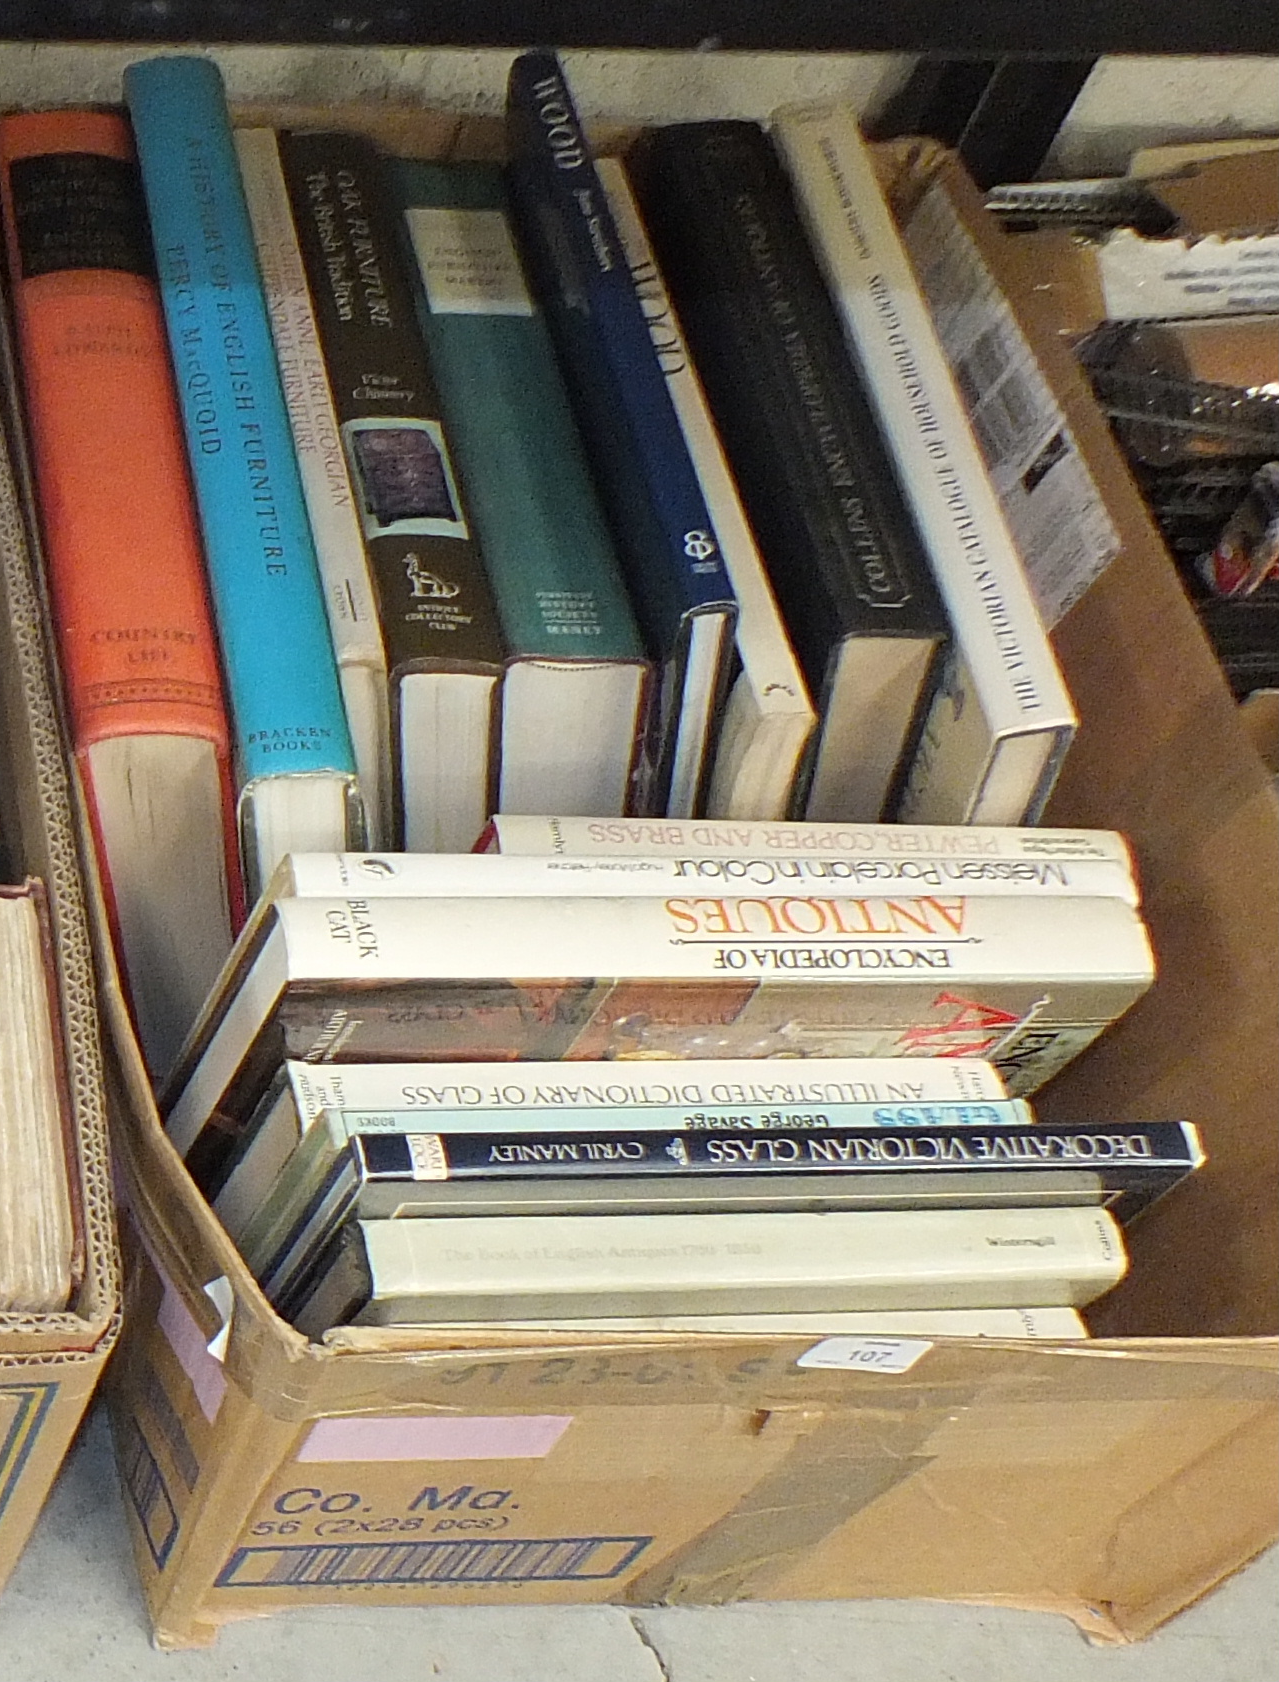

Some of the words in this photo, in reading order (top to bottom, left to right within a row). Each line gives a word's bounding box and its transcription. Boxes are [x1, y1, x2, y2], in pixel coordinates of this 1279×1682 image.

[531, 75, 585, 171] WOOD
[309, 201, 346, 253] British
[166, 244, 197, 317] PERCY
[211, 262, 232, 294] OF
[319, 251, 366, 323] Tradition
[865, 273, 900, 331] GOODS
[217, 301, 255, 411] ENGLISH
[884, 332, 938, 435] HOUSEHOLD
[277, 356, 318, 458] FURNITURE
[312, 411, 351, 510] GEORGIAN
[923, 434, 948, 461] OF
[240, 423, 288, 577] FURNITURE
[933, 463, 988, 568] CATALOGUE
[836, 492, 894, 596] COLLINS
[970, 566, 1027, 673] VICTORIAN
[91, 627, 197, 645] COUNTRY
[1010, 673, 1041, 713] THE
[248, 727, 332, 745] BRACKEN
[262, 740, 323, 754] BOOKS
[588, 823, 685, 846] BRASS
[694, 826, 752, 849] AND
[765, 829, 885, 853] COPPER
[671, 858, 776, 885] Colour
[773, 860, 806, 879] in
[819, 860, 942, 886] Porcelain
[950, 861, 1069, 887] Meissen
[324, 908, 352, 945] CAT
[665, 895, 967, 937] ANTIQUES
[345, 900, 380, 959] BLACK
[714, 948, 748, 969] OF
[757, 947, 952, 970] ENCYCLOPEDIA
[401, 1086, 484, 1106] GLASS
[490, 1084, 525, 1105] OF
[533, 1083, 704, 1106] DICTIONARY
[707, 1081, 877, 1105] ILLUSTRATED
[884, 1083, 925, 1102] AN
[683, 1112, 754, 1132] Savage
[761, 1112, 829, 1129] George
[872, 1106, 1001, 1127] GLASS
[487, 1142, 583, 1163] MANLEY
[586, 1140, 645, 1160] CYRIL
[706, 1137, 797, 1164] GLASS
[806, 1135, 971, 1161] VICTORIAN
[976, 1133, 1152, 1159] DECORATIVE
[847, 1347, 894, 1366] 107
[271, 1488, 373, 1517] Co.
[407, 1484, 523, 1514] Ma.
[251, 1519, 304, 1538] 56
[313, 1517, 427, 1537] (2x28
[434, 1515, 512, 1537] pcs)
